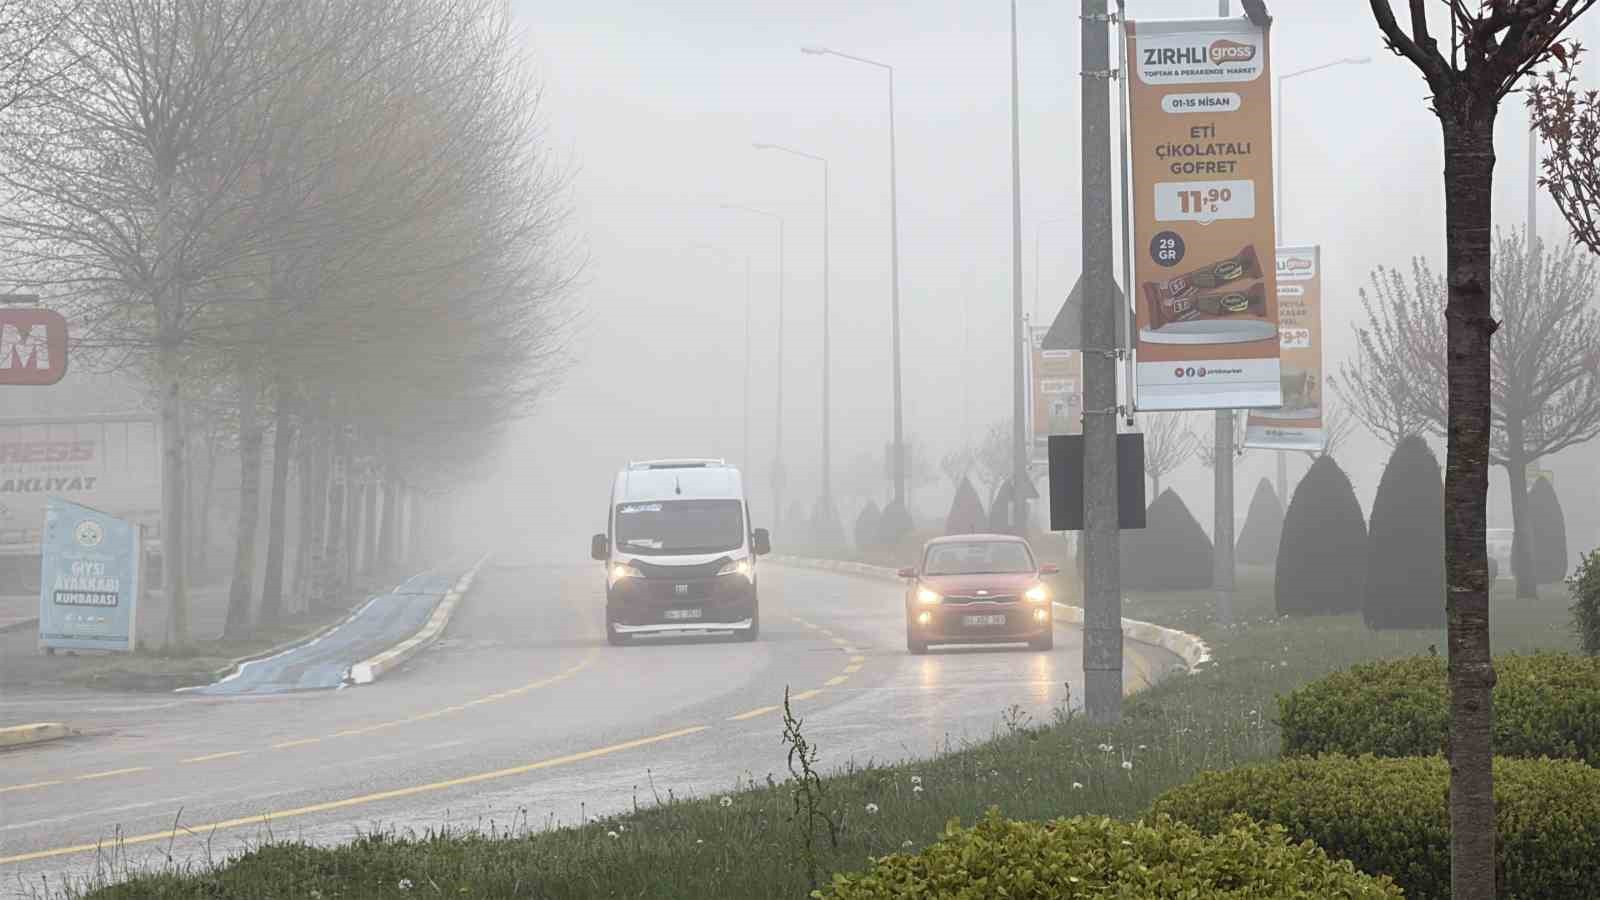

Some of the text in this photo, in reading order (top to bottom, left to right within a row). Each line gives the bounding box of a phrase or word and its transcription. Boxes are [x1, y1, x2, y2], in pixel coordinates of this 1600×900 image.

[1144, 46, 1252, 66] ZIRHLI gross
[1181, 68, 1224, 77] PERAKENDE
[1190, 122, 1216, 139] ETİ
[1155, 142, 1251, 161] ÇİKOLATALI
[1170, 160, 1238, 175] GOFRET
[1159, 238, 1176, 250] 29
[1158, 249, 1177, 261] GR
[55, 592, 117, 606] KUMBARASI
